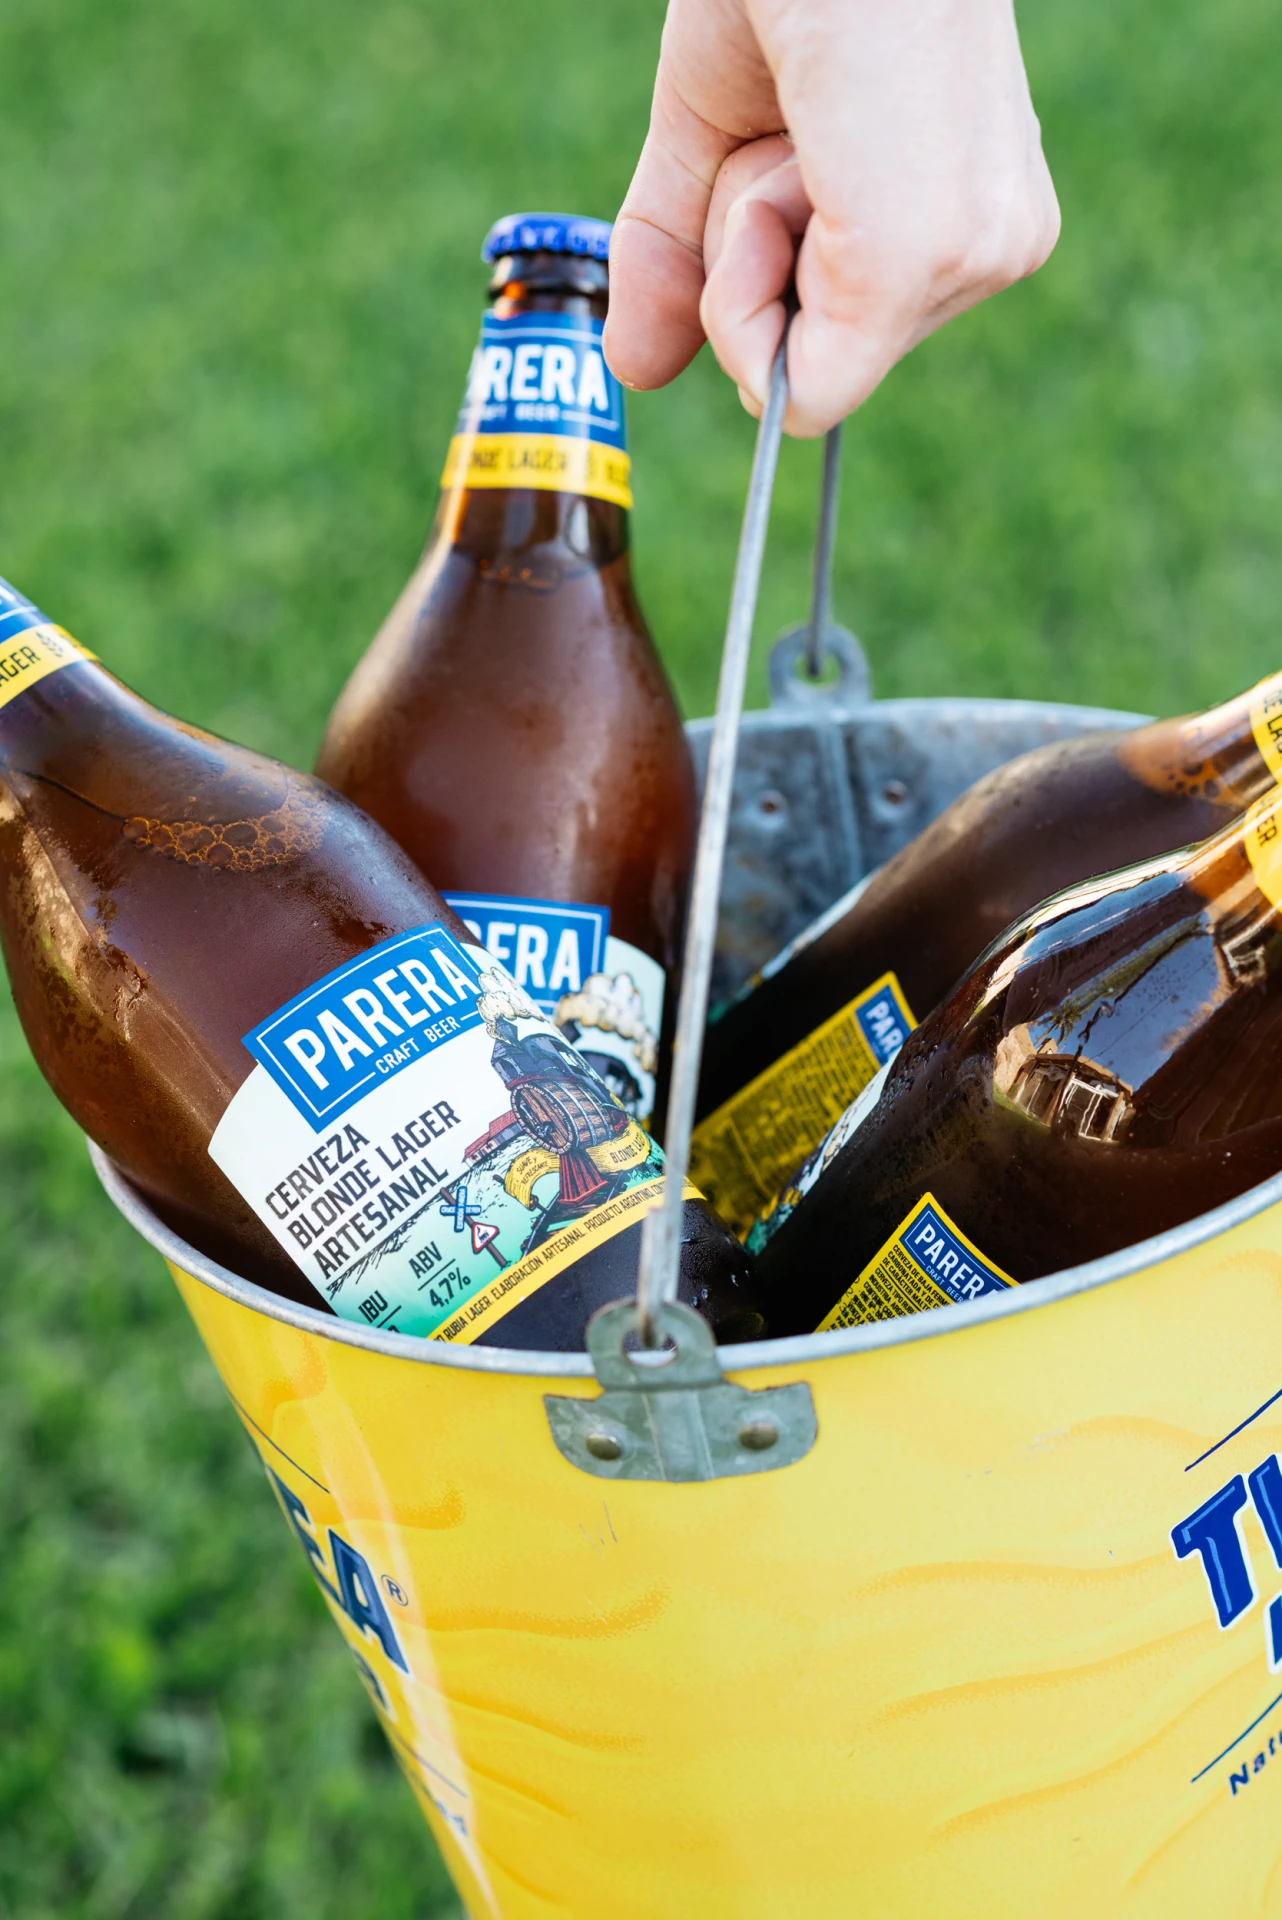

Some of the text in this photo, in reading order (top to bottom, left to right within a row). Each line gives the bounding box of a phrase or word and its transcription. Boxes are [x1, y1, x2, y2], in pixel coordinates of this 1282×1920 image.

[466, 344, 608, 411] RERA
[283, 947, 481, 1091] PARERA
[375, 1016, 461, 1074] CRAFT BEER
[265, 1123, 370, 1220] CERVEZA
[287, 1159, 381, 1250] BLONDE
[375, 1100, 461, 1171] LAGER
[313, 1157, 449, 1279] ARTESANAL
[408, 1241, 443, 1279] ABV
[443, 1316, 468, 1341] RUBIA
[491, 1256, 544, 1300] ELABORACIÓN
[584, 1204, 622, 1232] PRODUCTO
[882, 1257, 890, 1267] DE
[888, 1265, 913, 1295] CARÁCTER
[887, 1251, 921, 1293] CARBONATADA
[925, 1296, 934, 1305] DE
[893, 1245, 913, 1270] CERVEZA
[911, 1268, 920, 1279] DE
[918, 1276, 932, 1293] BAJA
[926, 1265, 945, 1286] CRAFT
[358, 1290, 388, 1323] IBU
[429, 1268, 471, 1307] 4,7%
[863, 1281, 885, 1308] CONTIENE
[869, 1274, 891, 1303] INDUSTRIA
[875, 1268, 893, 1292] CERVEZA
[892, 1289, 904, 1303] TIPO
